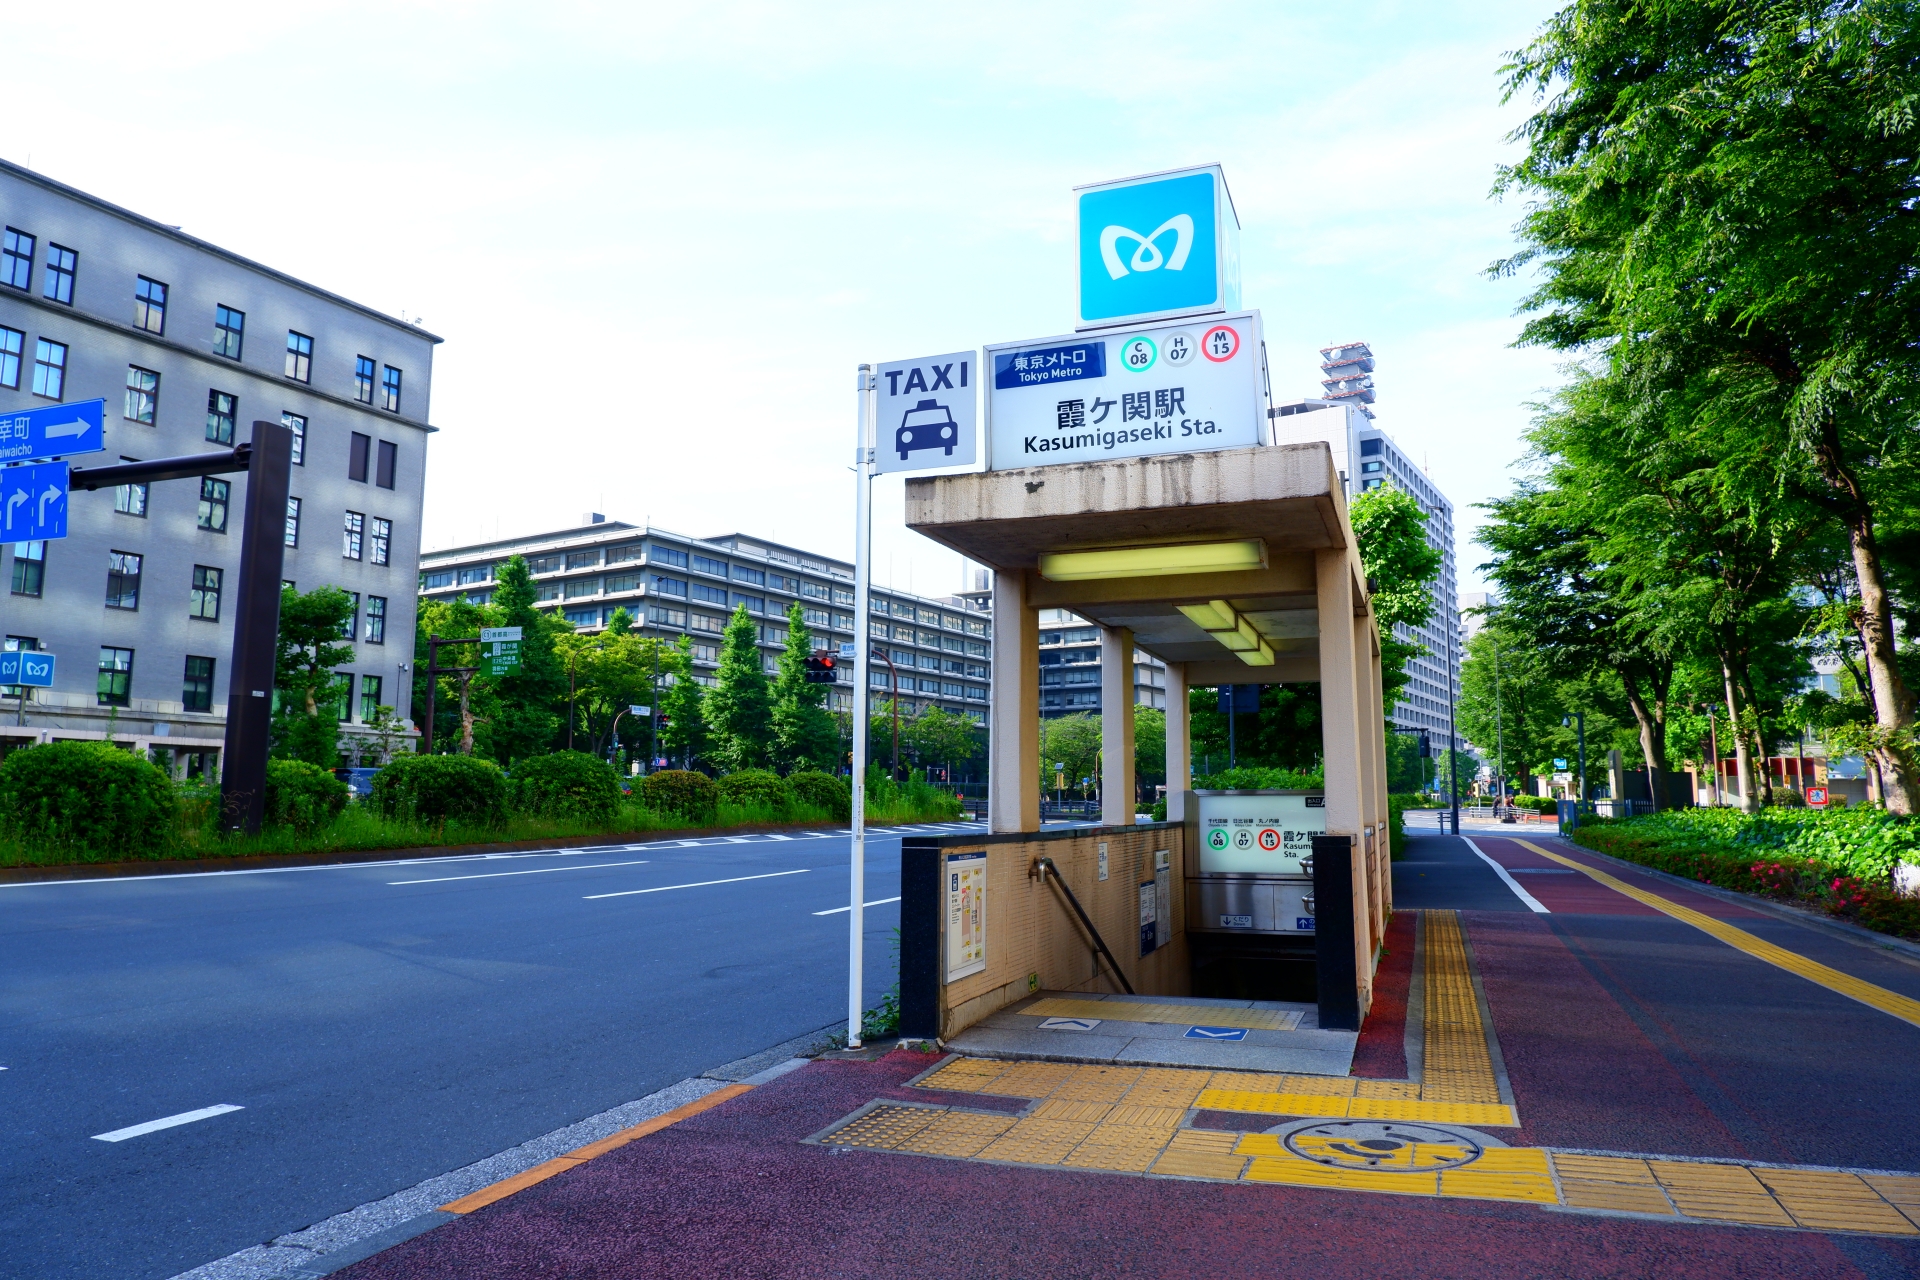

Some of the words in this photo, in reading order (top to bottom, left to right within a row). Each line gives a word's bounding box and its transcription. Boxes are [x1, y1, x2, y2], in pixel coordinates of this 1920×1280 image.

[1174, 337, 1184, 348] H
[1214, 332, 1227, 342] M
[1134, 342, 1143, 352] C
[1213, 343, 1230, 355] 15
[1014, 349, 1086, 371] 東京メトロ
[1130, 353, 1148, 365] 08
[1170, 348, 1189, 360] 07
[884, 361, 968, 396] TAXI
[1019, 372, 1049, 382] Tokyo
[1051, 368, 1082, 378] Metro
[1056, 386, 1186, 430] 霞ケ関駅
[1024, 420, 1172, 454] Kasumigaseki
[1180, 418, 1223, 437] Sta.
